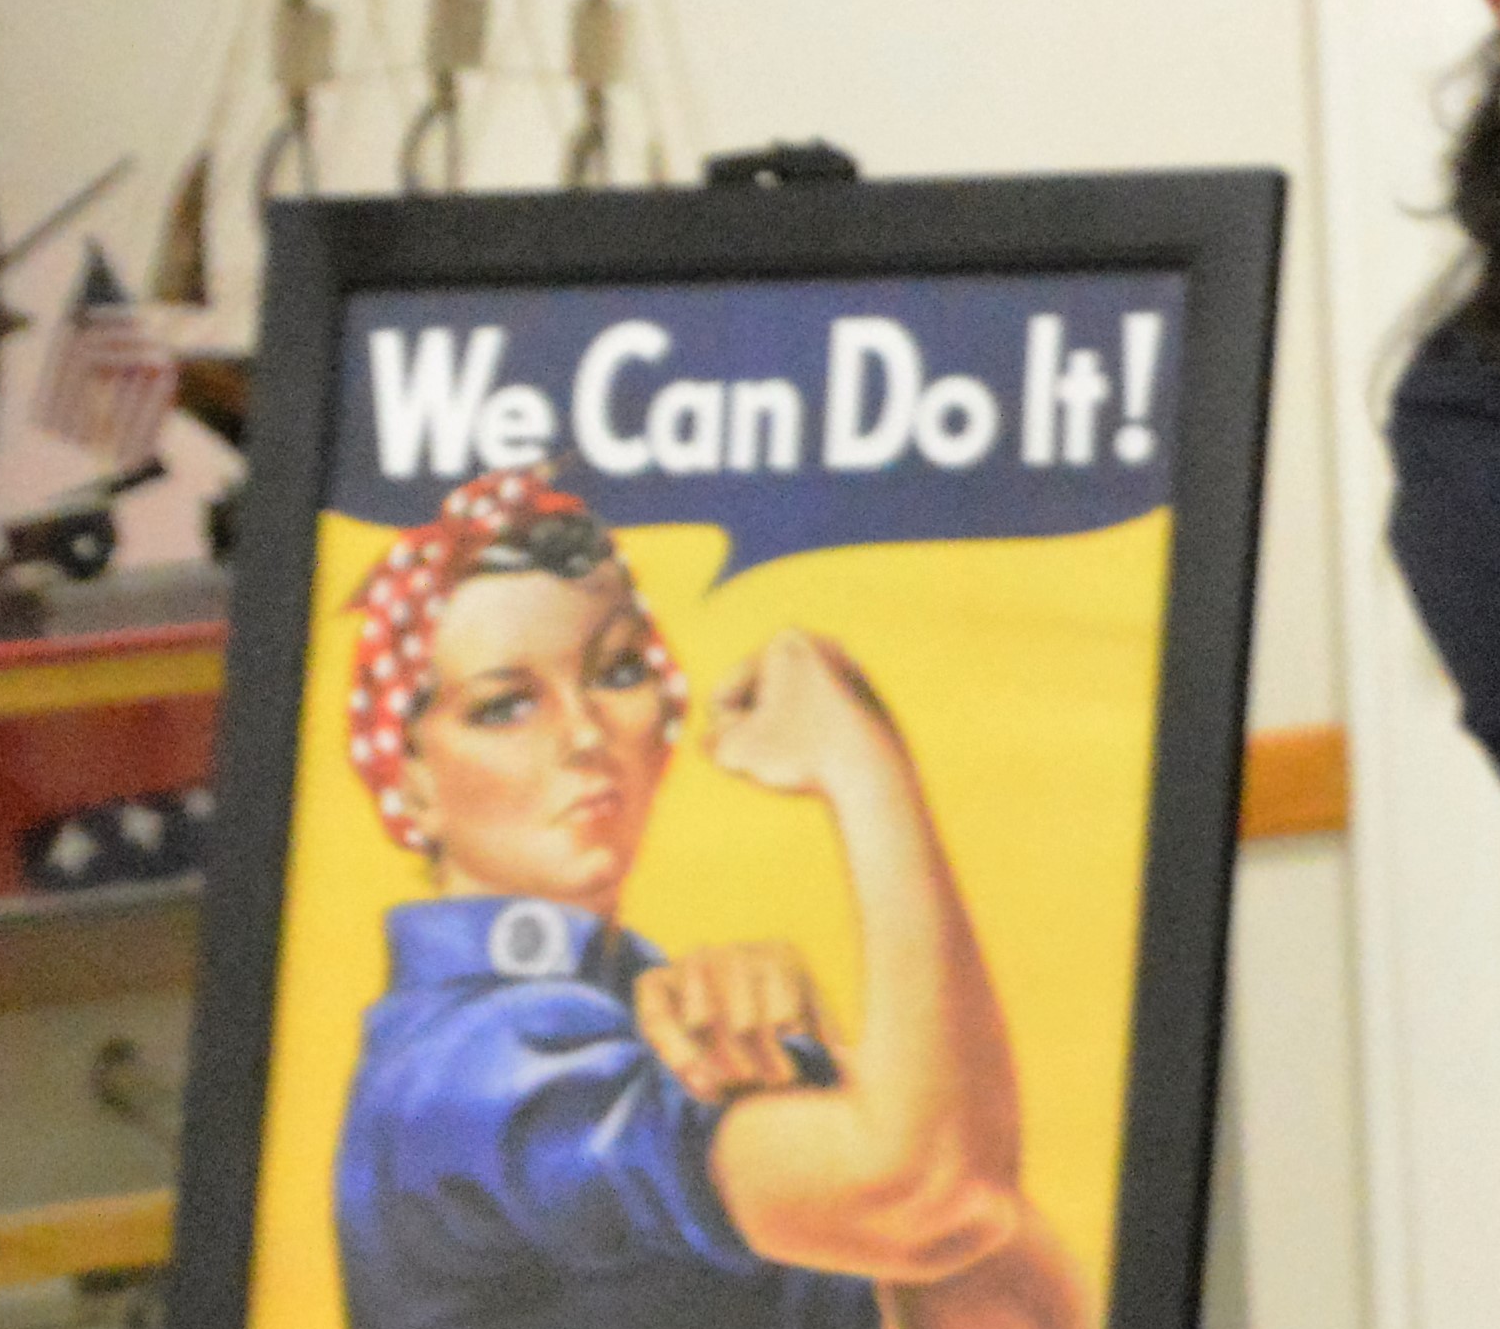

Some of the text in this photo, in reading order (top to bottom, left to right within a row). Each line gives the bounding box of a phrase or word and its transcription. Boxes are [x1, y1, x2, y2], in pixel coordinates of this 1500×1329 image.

[368, 311, 1164, 478] We Can Do It!
